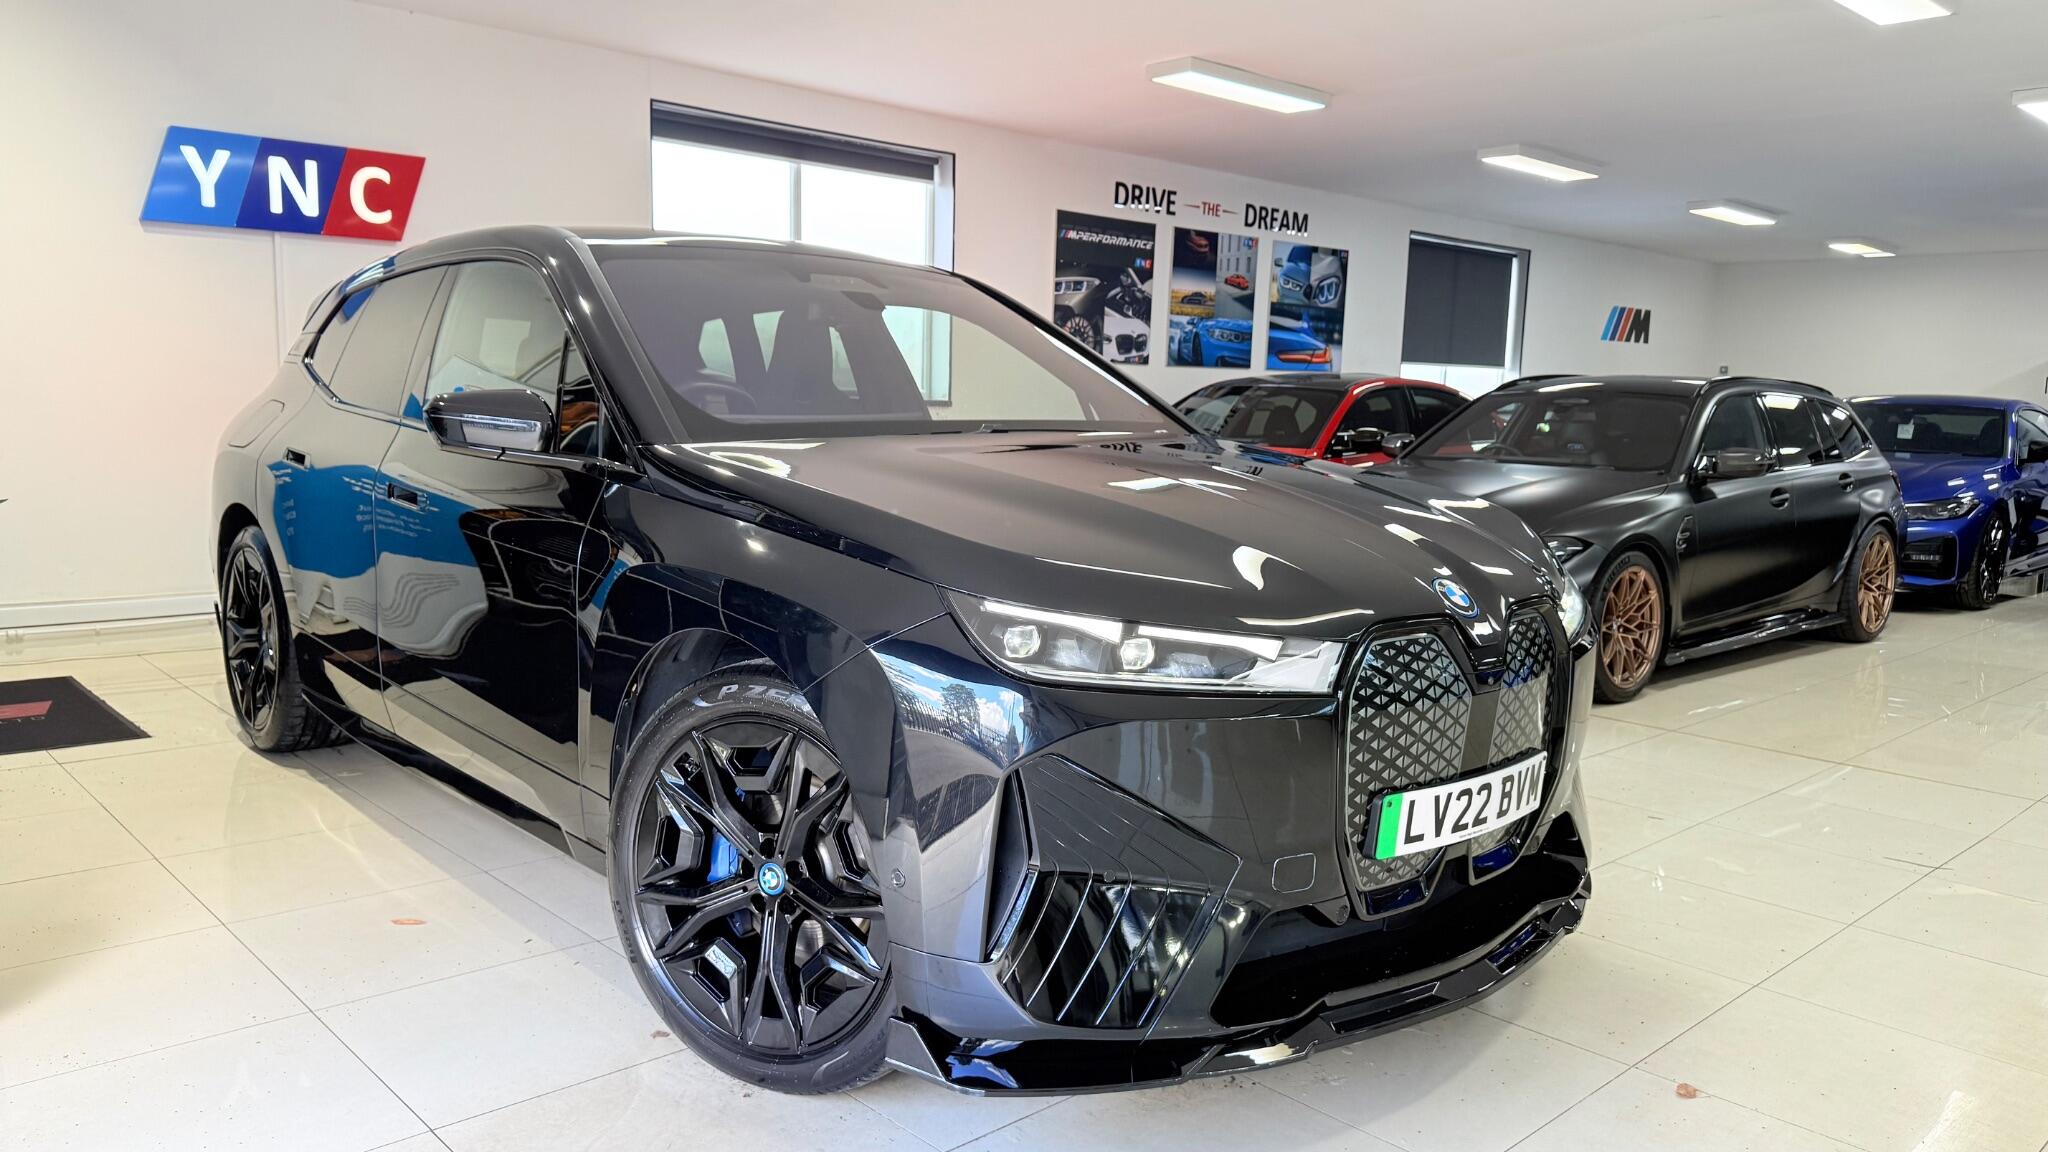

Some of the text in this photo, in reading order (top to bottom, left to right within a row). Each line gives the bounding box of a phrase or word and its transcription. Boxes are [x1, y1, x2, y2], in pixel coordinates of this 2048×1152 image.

[179, 144, 393, 225] YNC
[1114, 181, 1309, 235] DRIVE THE DREAM
[1403, 760, 1543, 845] LV22 BVM
